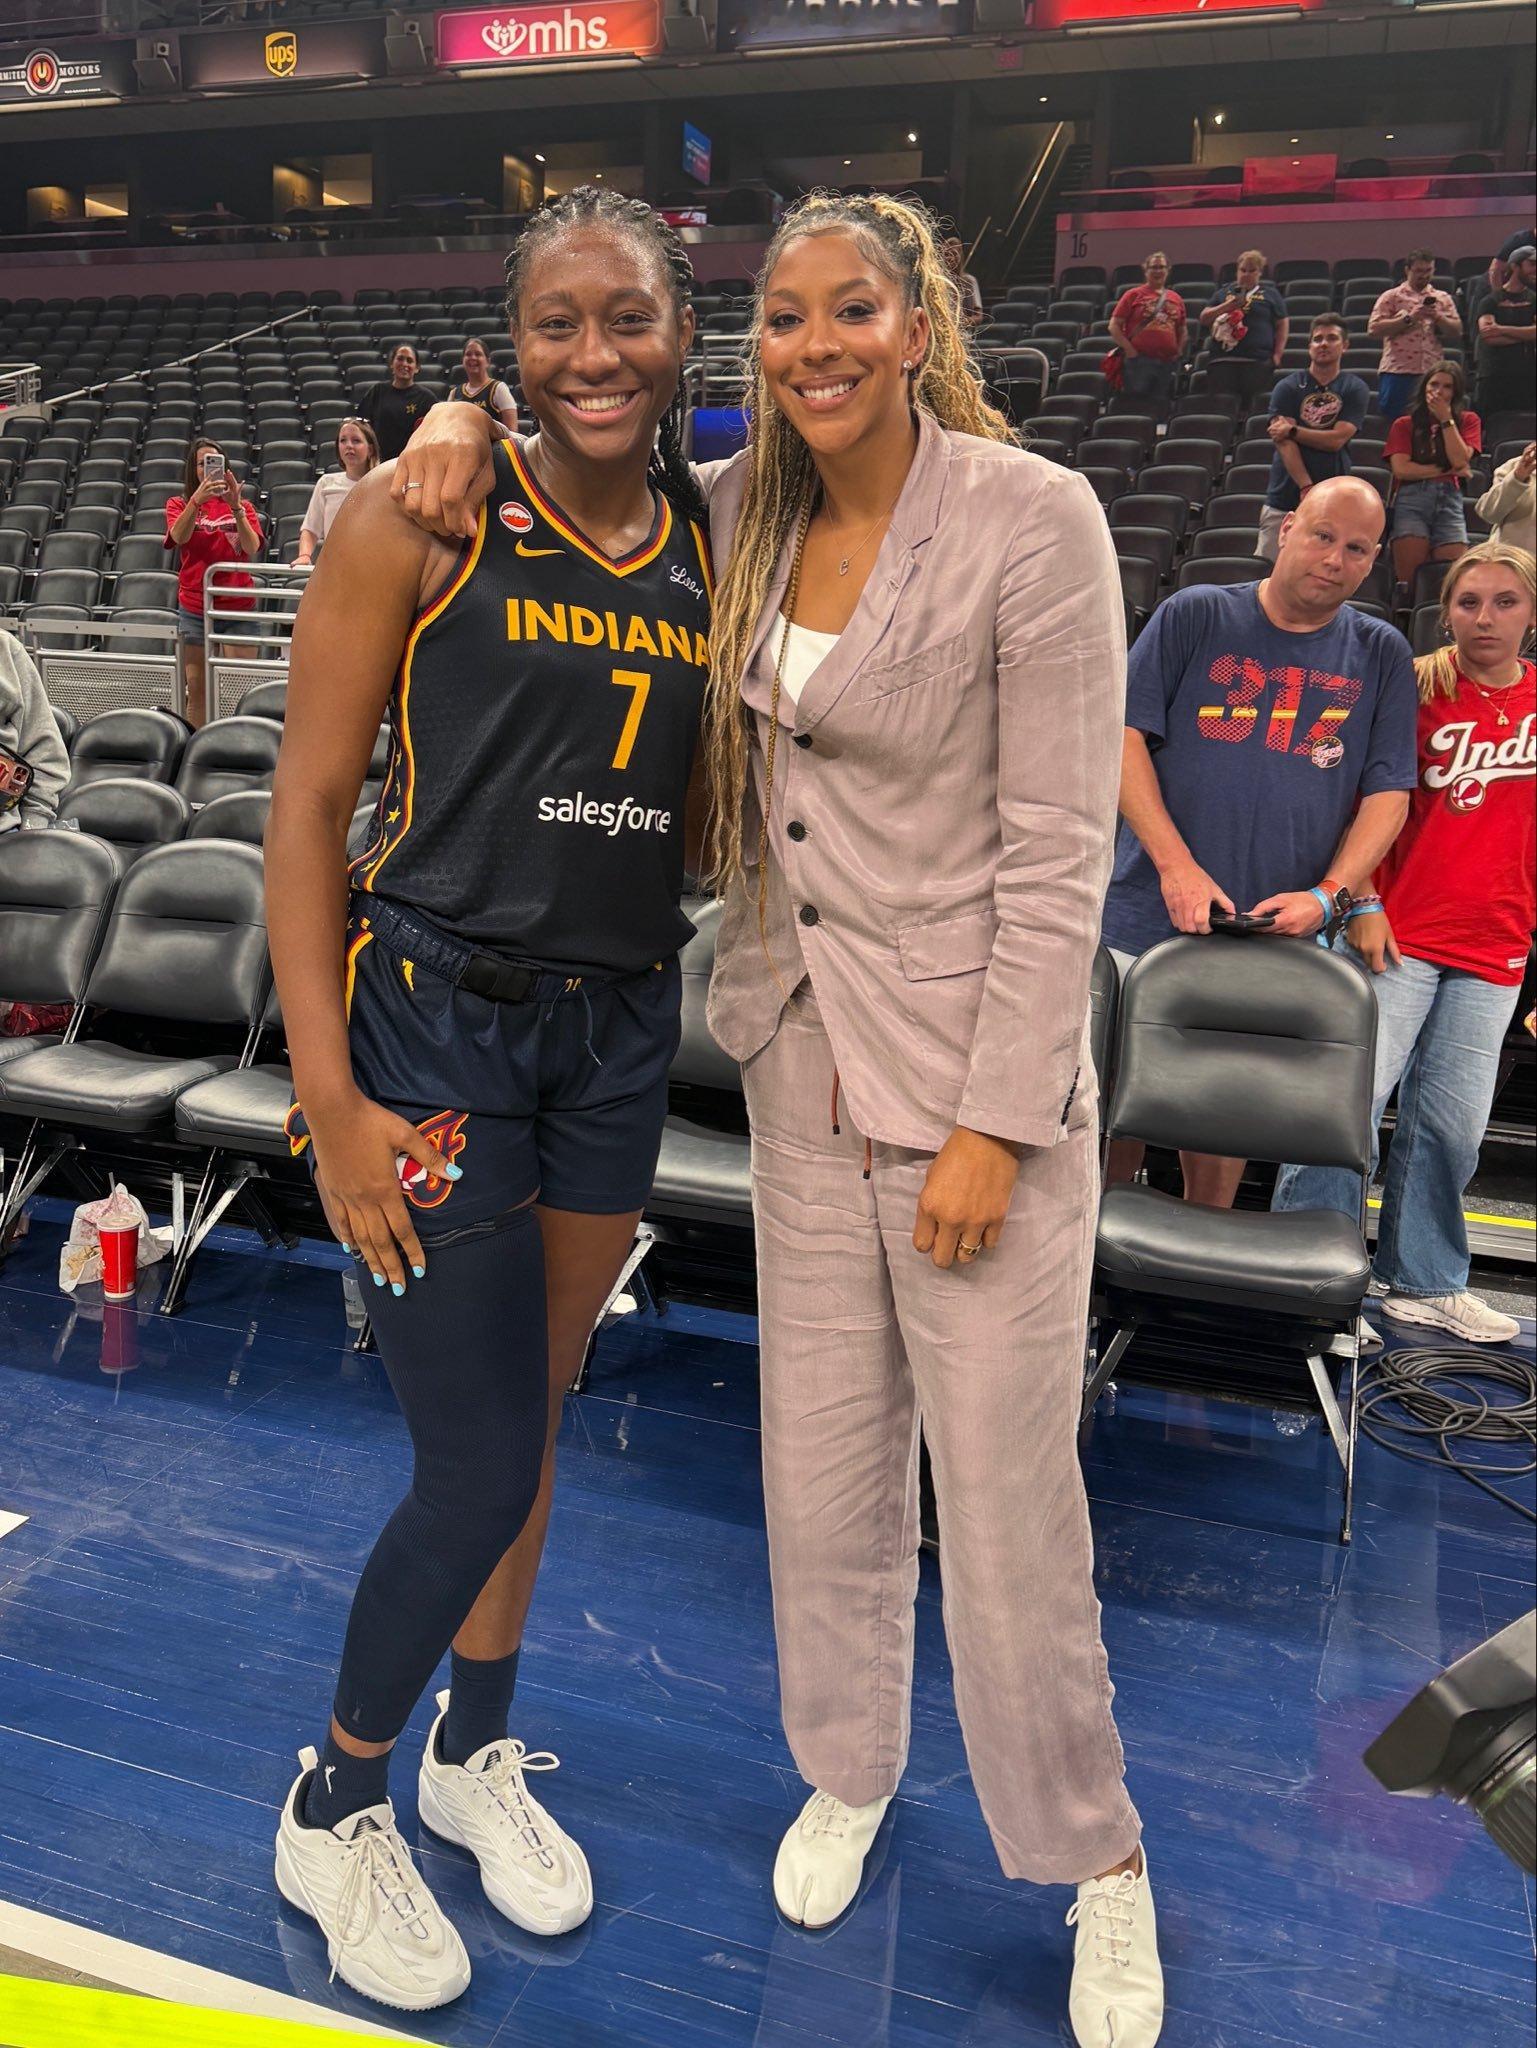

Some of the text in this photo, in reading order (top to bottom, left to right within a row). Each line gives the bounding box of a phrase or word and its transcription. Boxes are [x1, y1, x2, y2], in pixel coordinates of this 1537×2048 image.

[529, 8, 608, 54] mhs
[59, 64, 100, 76] MOTORS
[268, 45, 294, 70] ups
[1071, 231, 1088, 258] 16
[669, 565, 704, 600] Lilly
[506, 598, 711, 672] INDIANA
[612, 668, 651, 770] 7
[1197, 653, 1363, 756] 317
